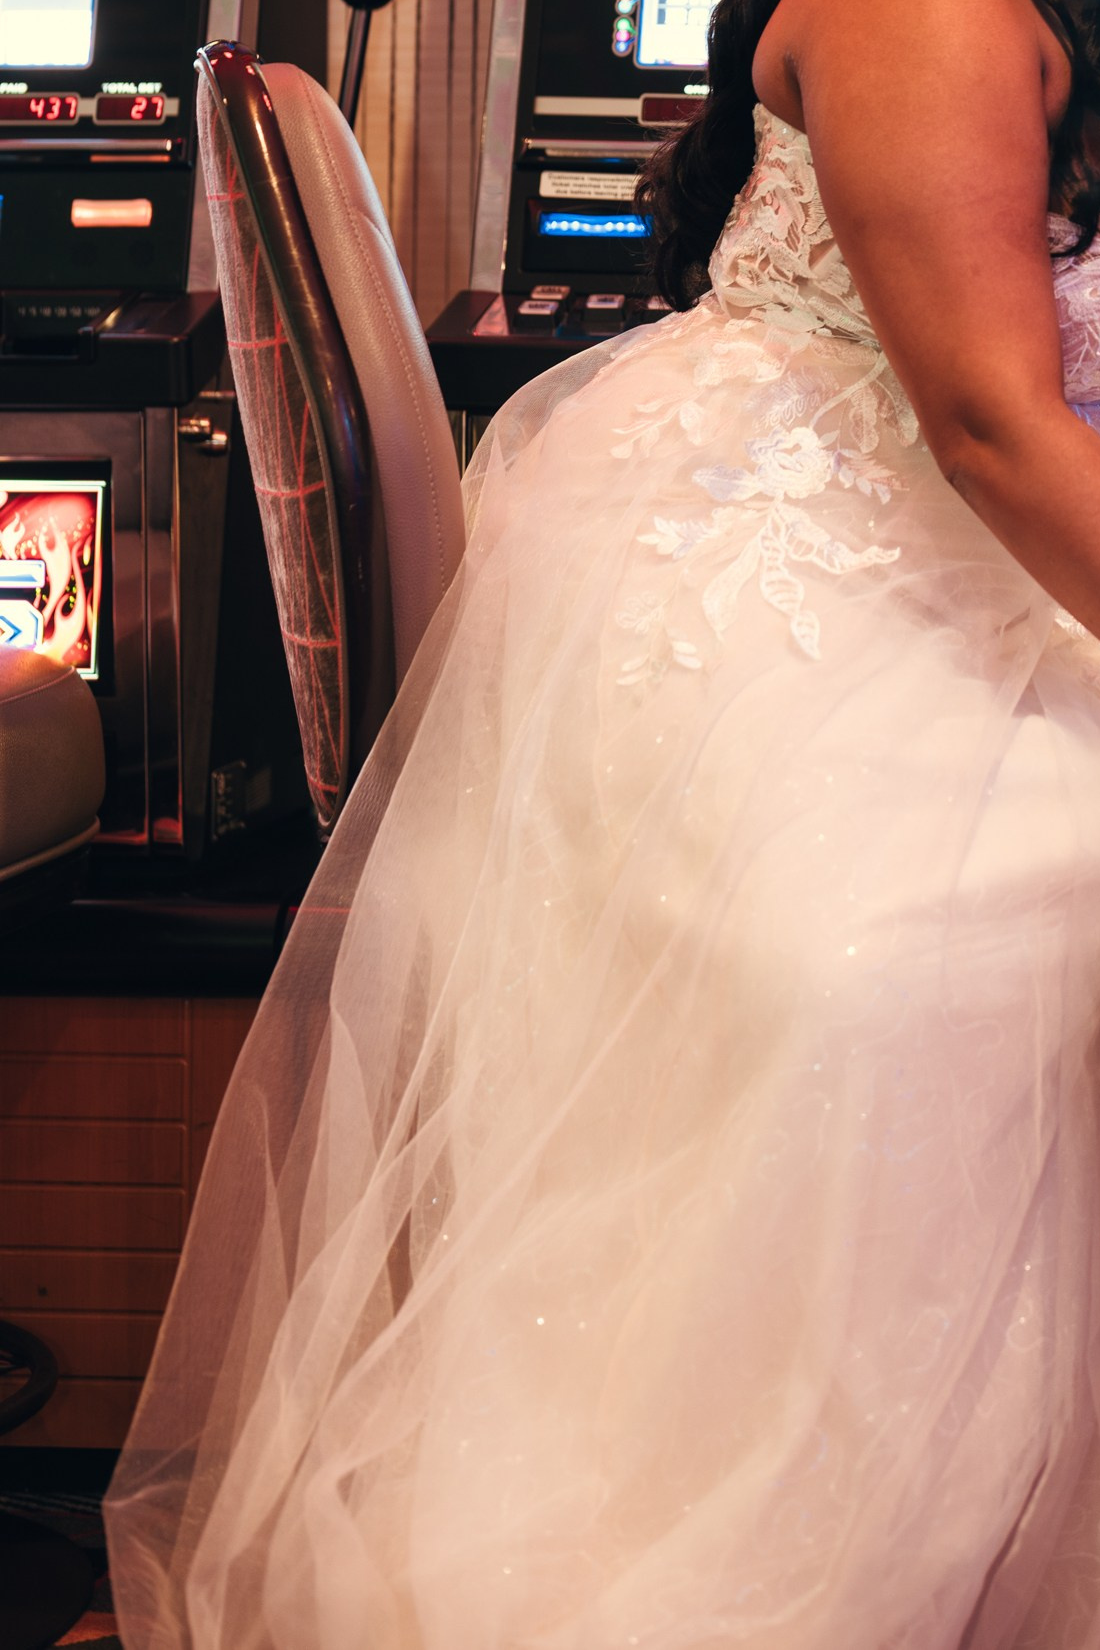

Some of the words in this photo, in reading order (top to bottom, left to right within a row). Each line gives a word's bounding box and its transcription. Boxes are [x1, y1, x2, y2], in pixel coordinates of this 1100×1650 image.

[102, 82, 137, 94] TOTAL
[30, 97, 77, 119] 437
[131, 97, 163, 119] 27
